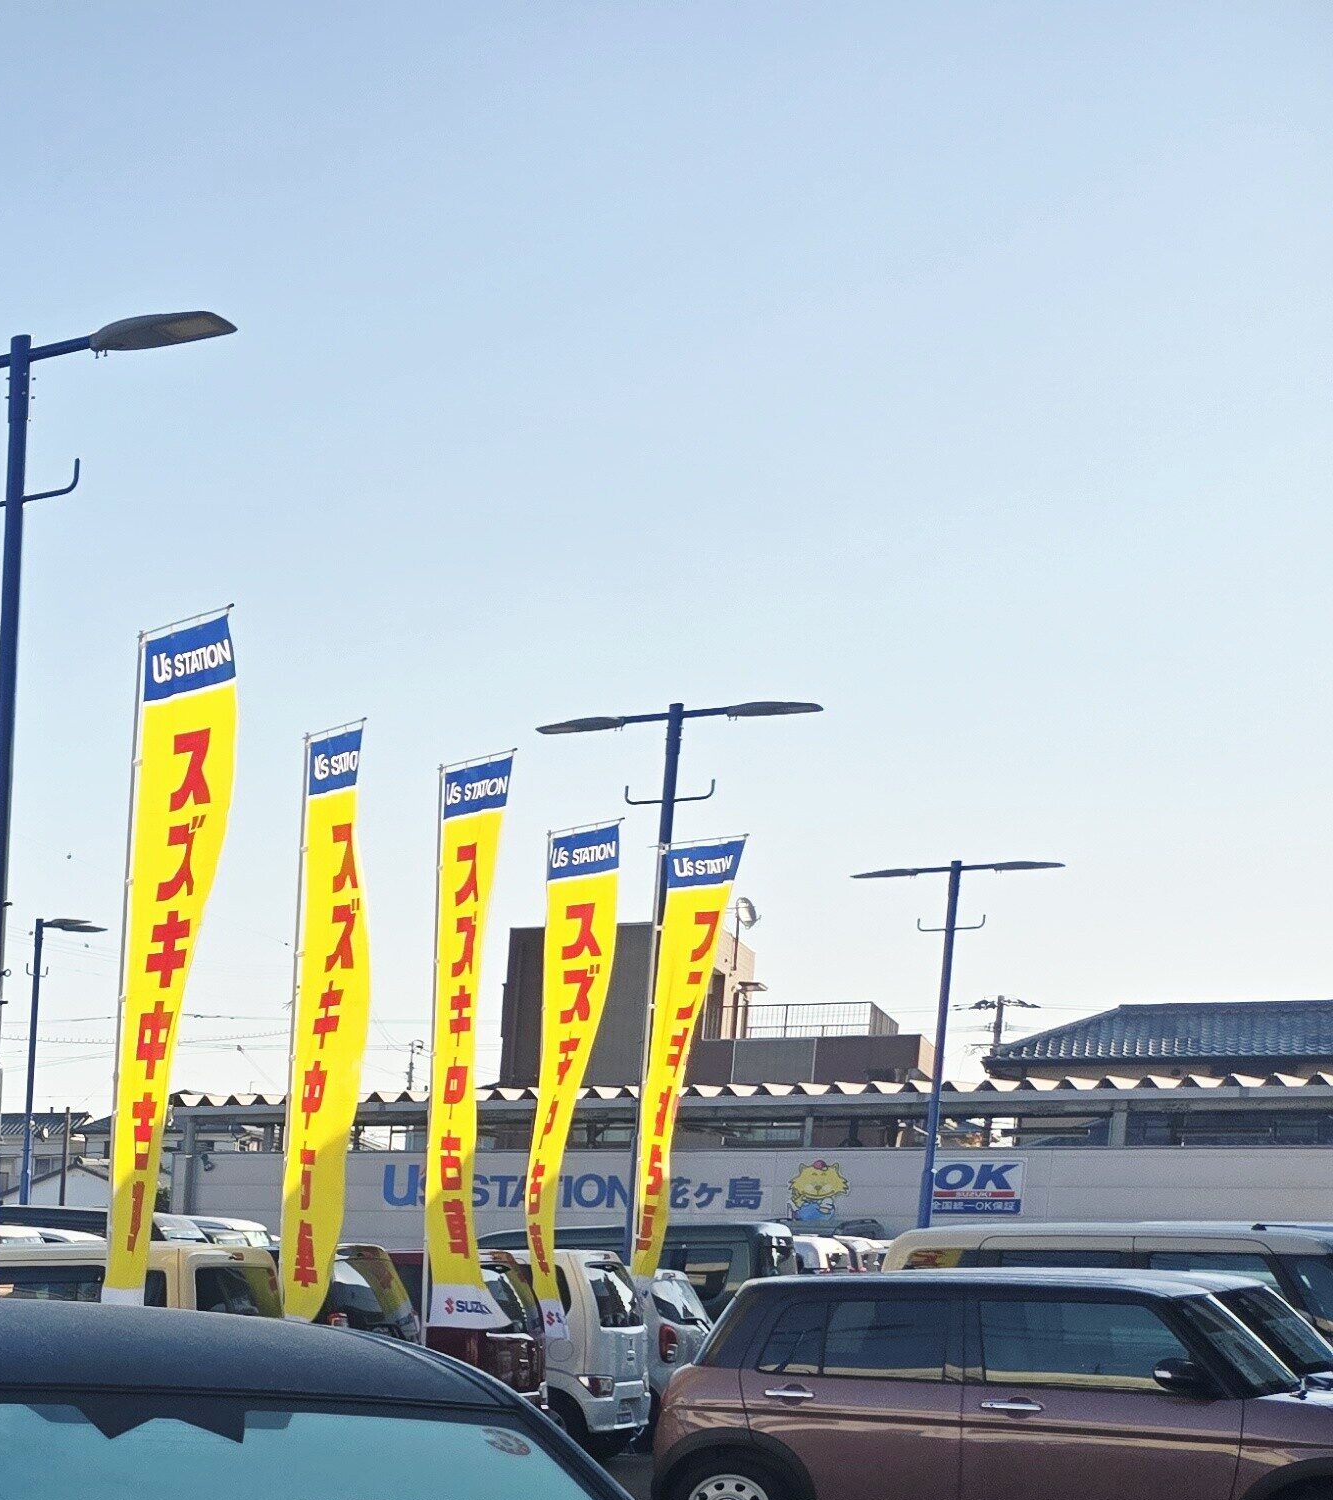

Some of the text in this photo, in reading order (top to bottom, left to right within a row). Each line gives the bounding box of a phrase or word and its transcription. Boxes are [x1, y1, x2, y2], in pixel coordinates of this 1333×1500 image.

[174, 639, 231, 677] STATION
[465, 775, 508, 802] STATION
[572, 841, 615, 865] STATION
[934, 1163, 1019, 1190] OK
